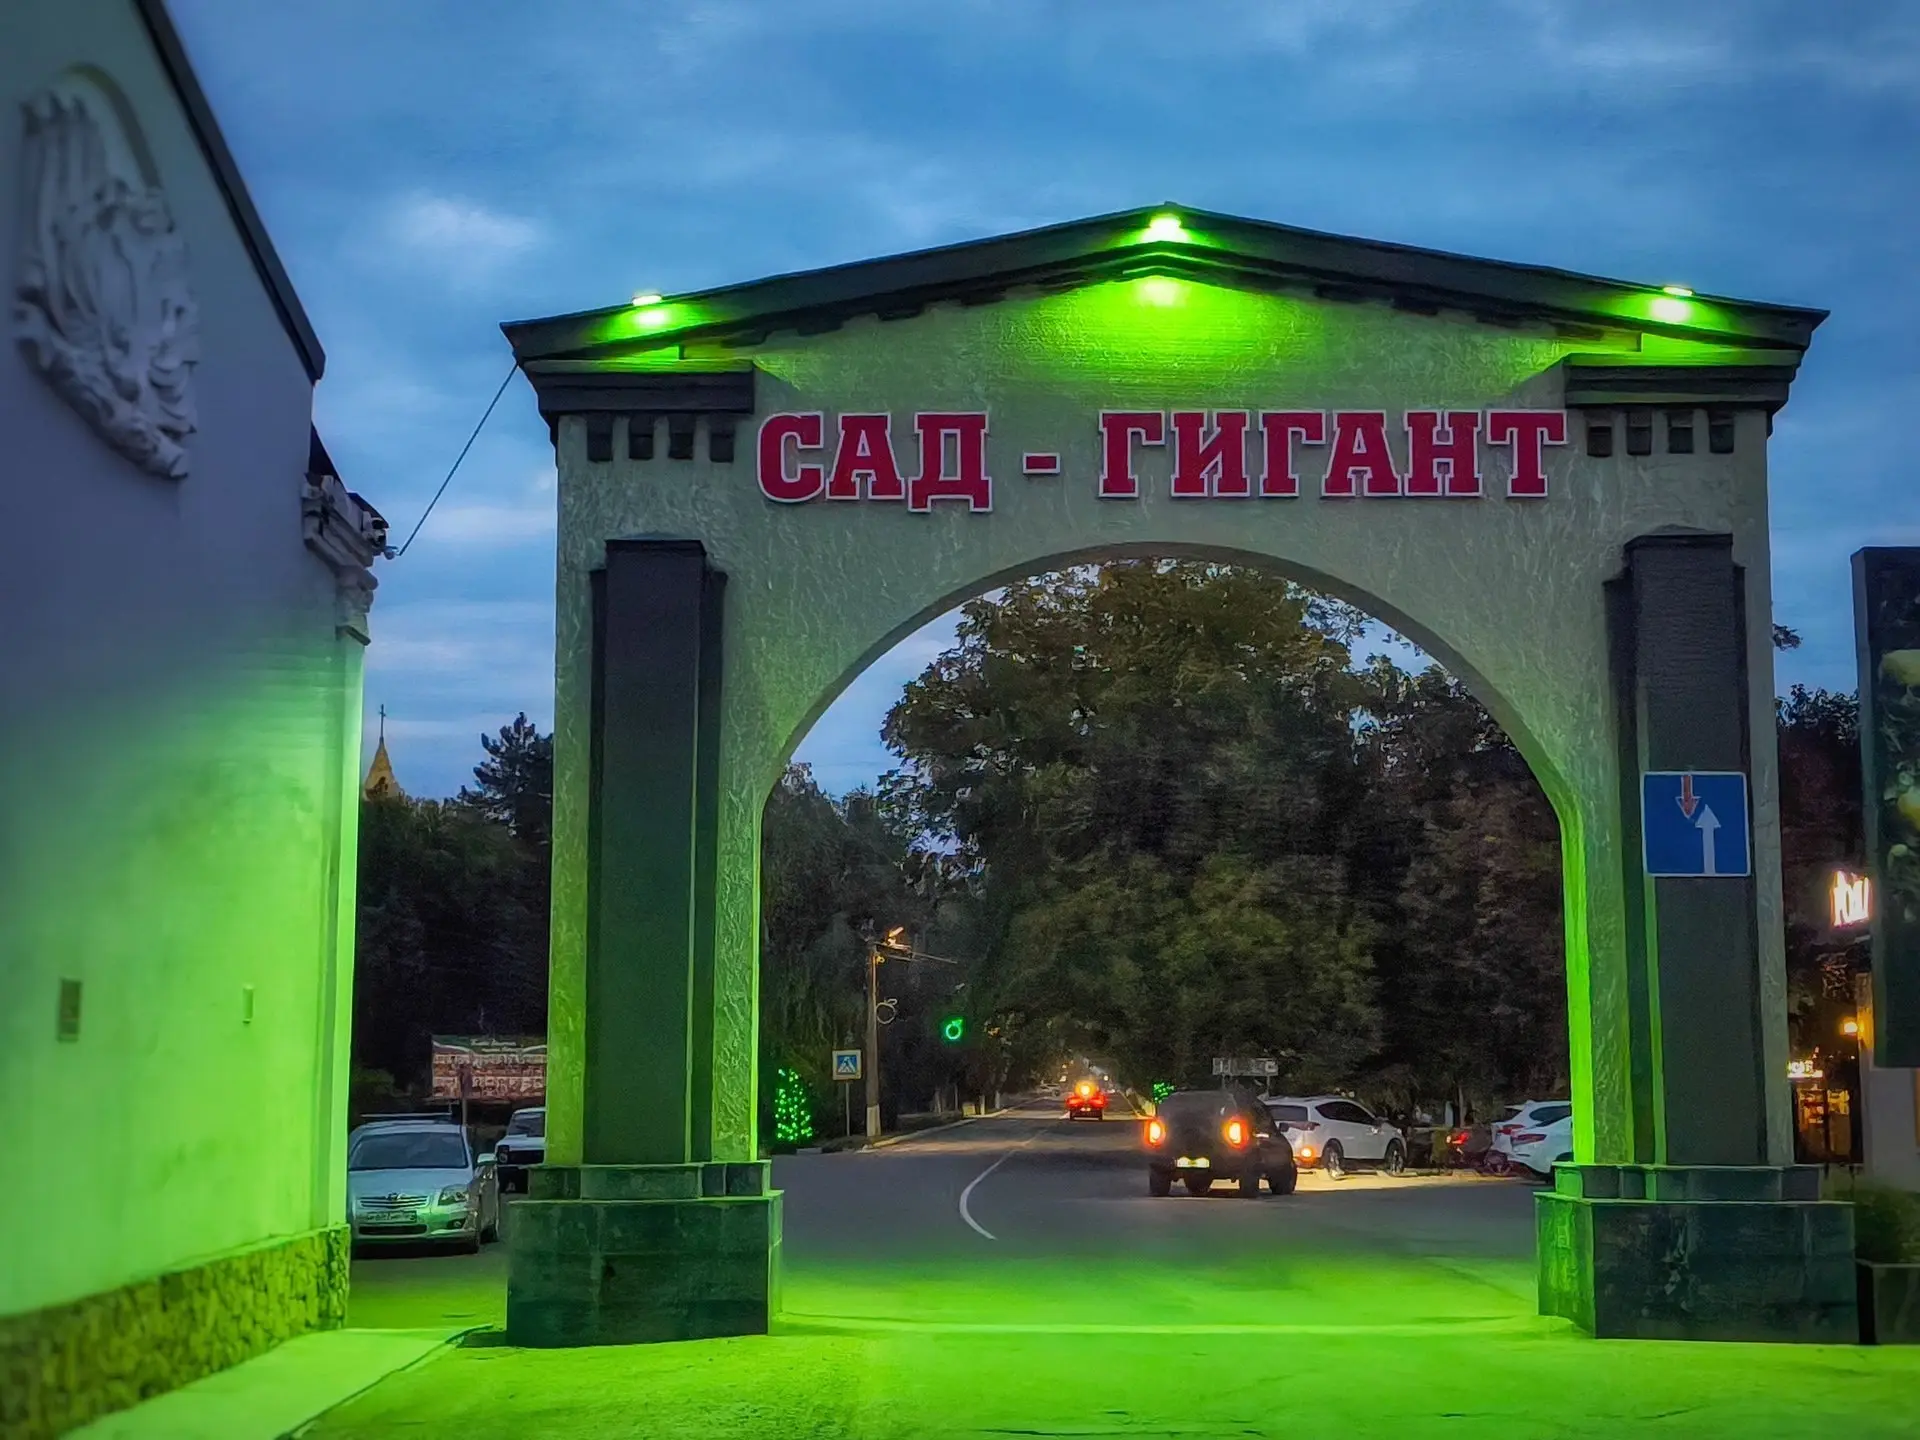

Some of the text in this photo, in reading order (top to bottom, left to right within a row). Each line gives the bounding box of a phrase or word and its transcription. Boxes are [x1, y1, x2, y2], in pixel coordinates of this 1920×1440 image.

[757, 409, 1568, 512] САД - ГИГАНТ
